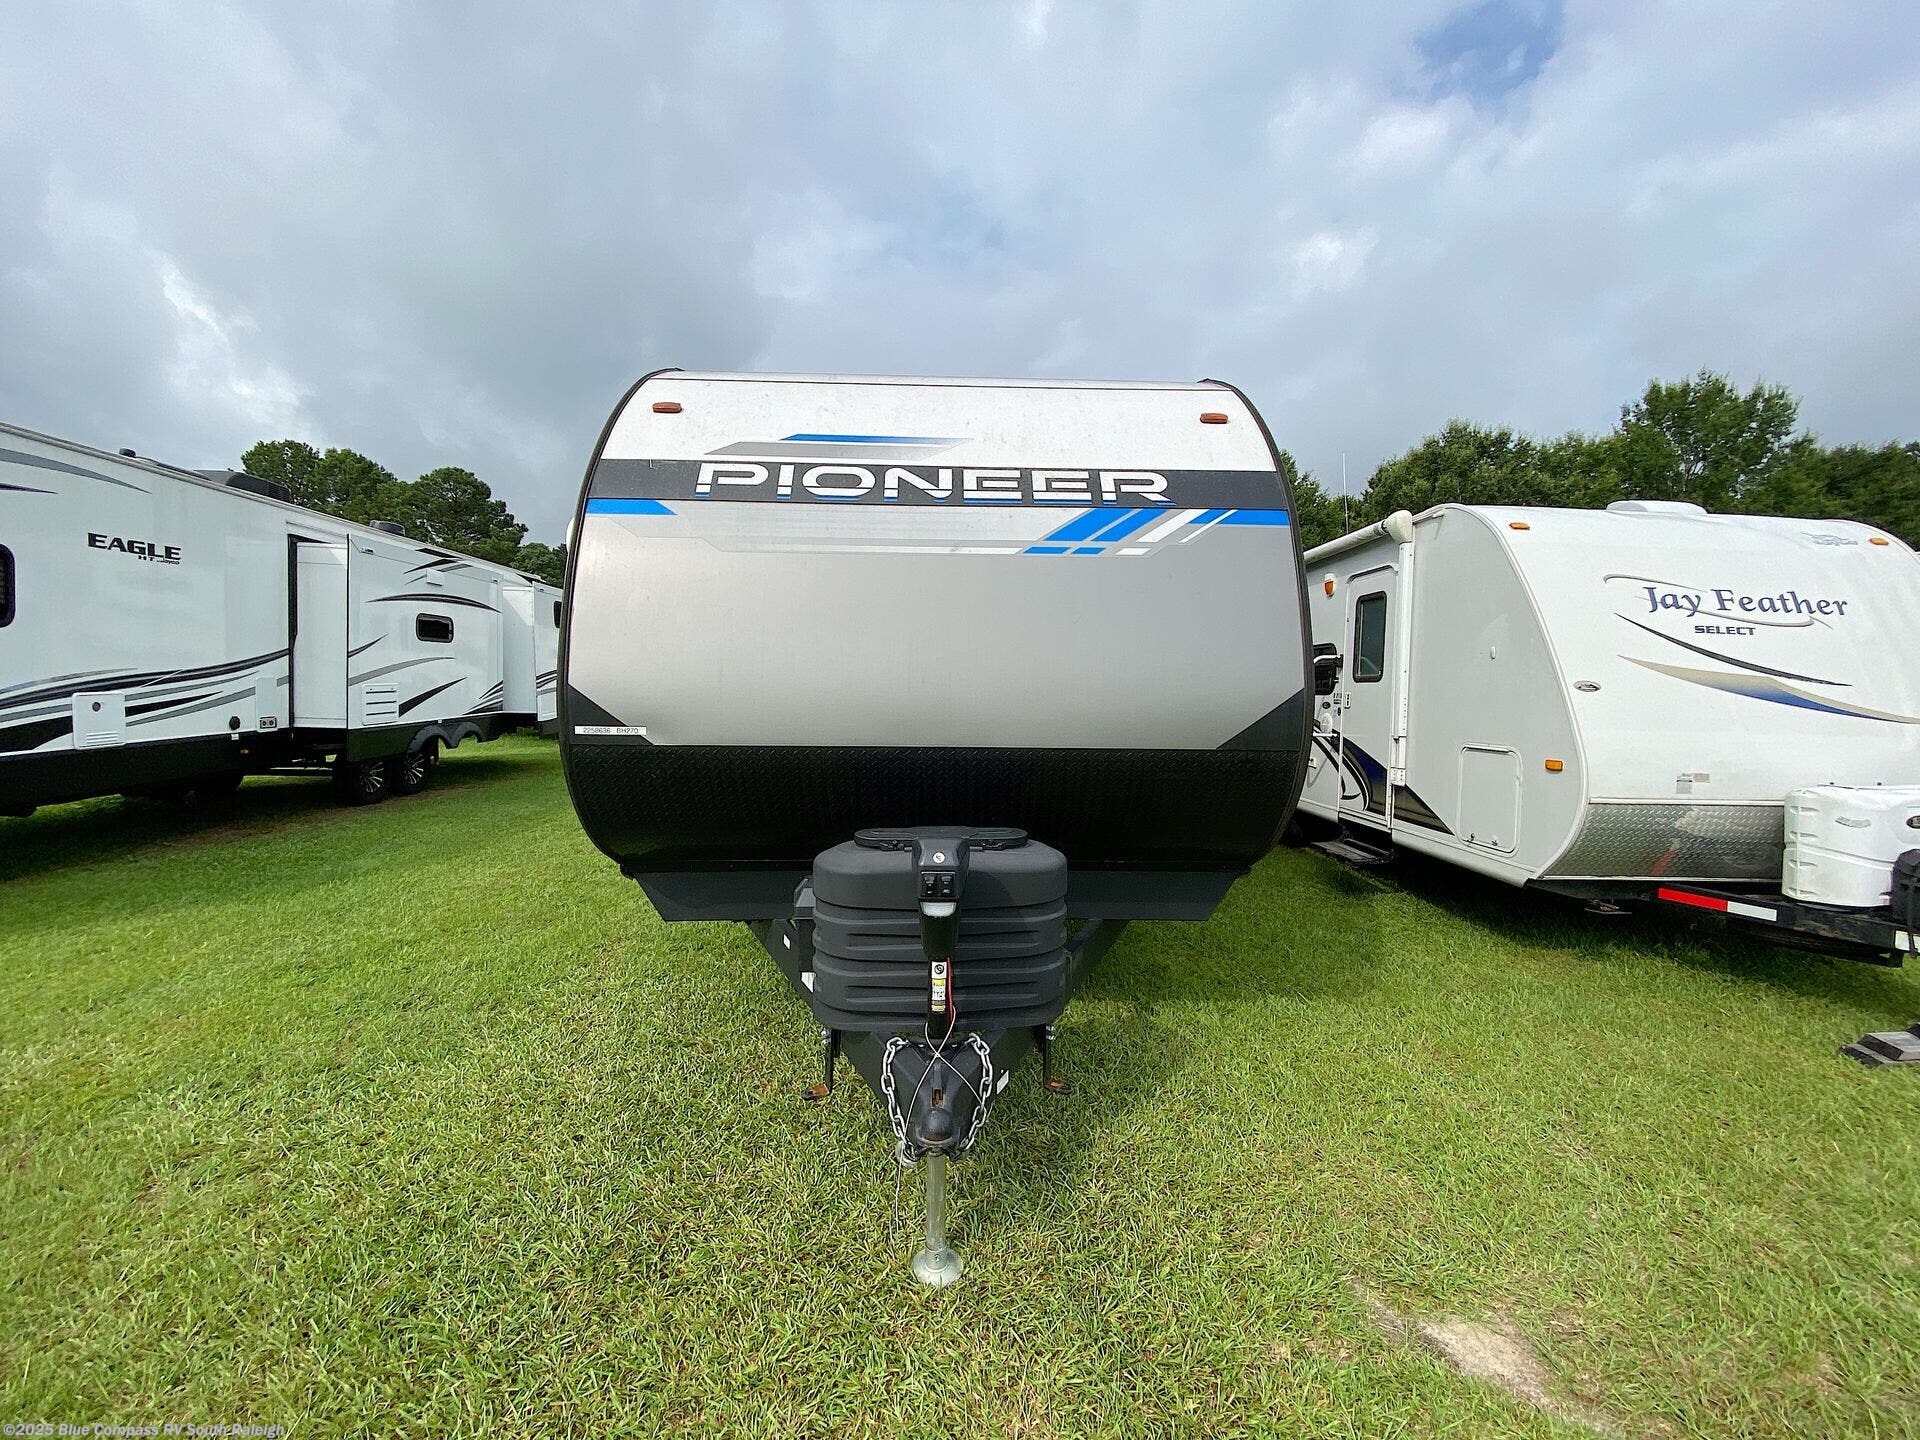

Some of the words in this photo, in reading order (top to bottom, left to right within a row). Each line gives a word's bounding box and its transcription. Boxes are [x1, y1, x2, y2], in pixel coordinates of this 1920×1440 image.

[694, 461, 1177, 506] PIONEER
[87, 532, 181, 561] EAGLE
[1642, 586, 1702, 618] Jay
[1710, 588, 1849, 616] Feather
[1694, 625, 1756, 636] SELECT
